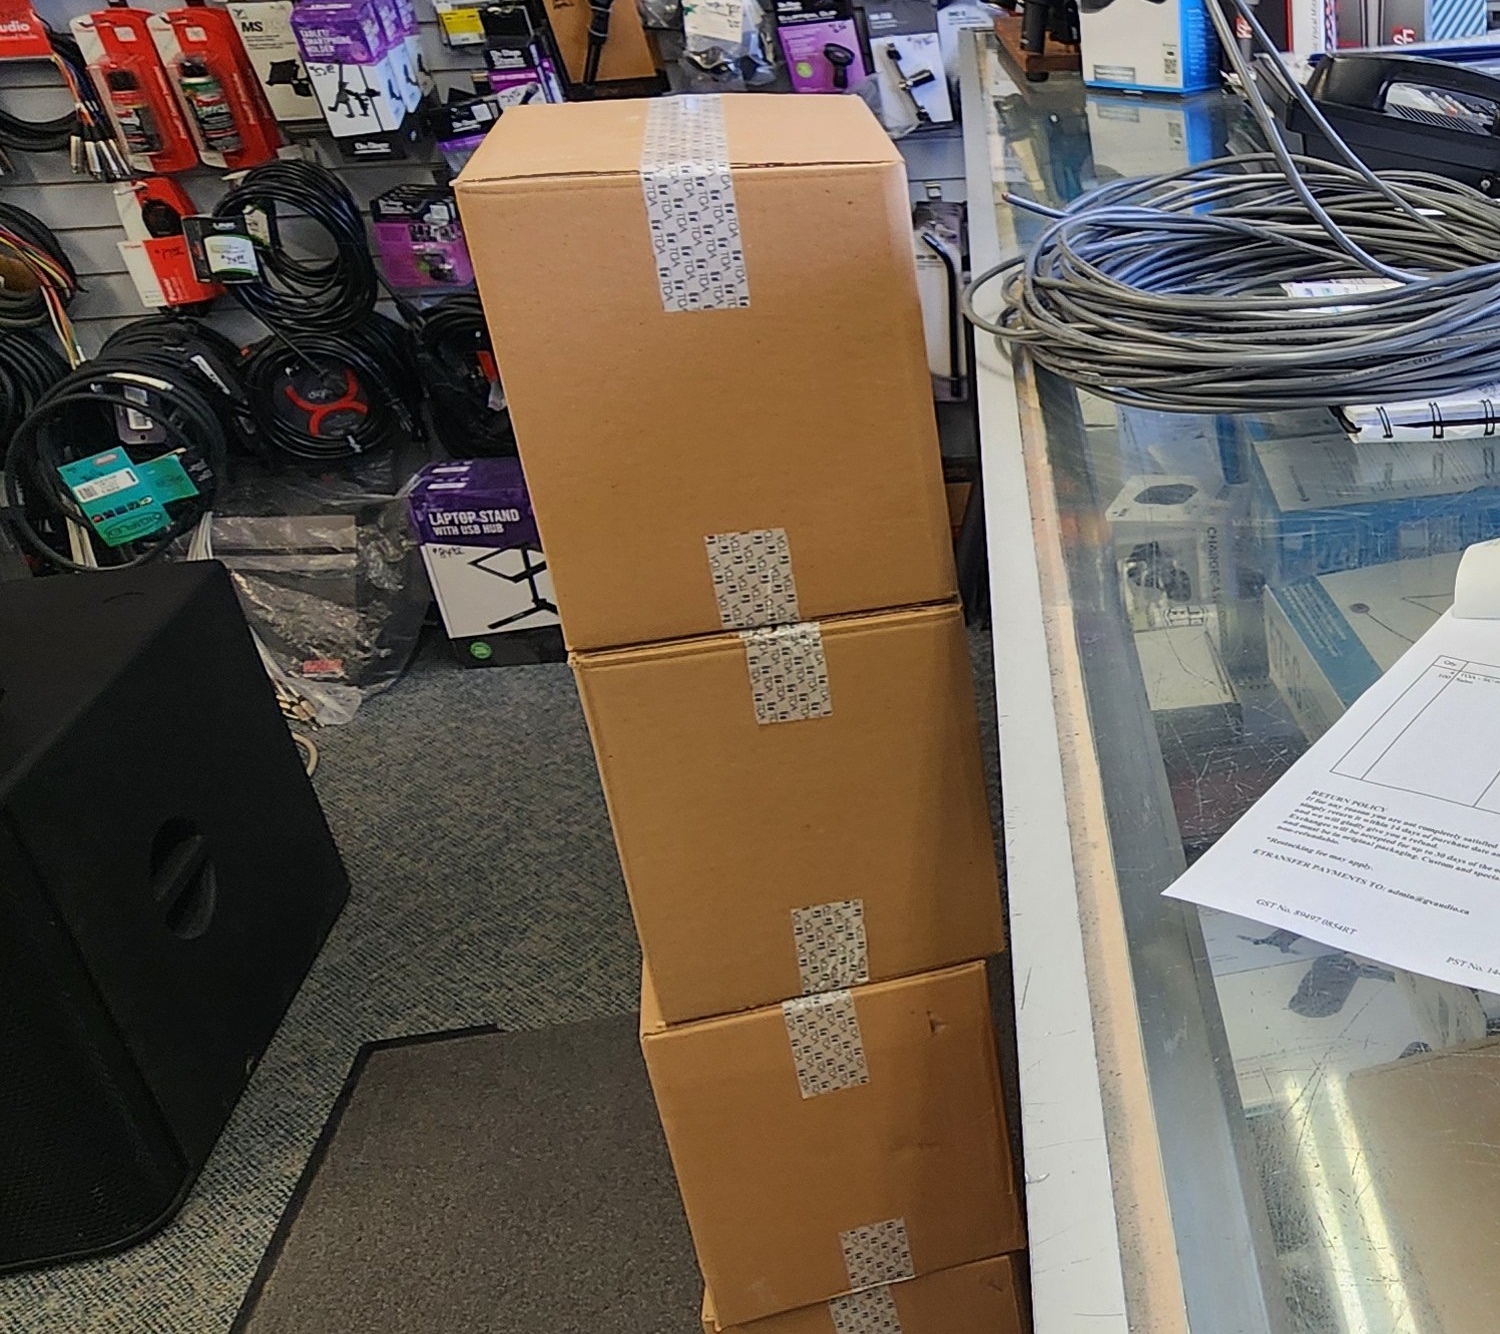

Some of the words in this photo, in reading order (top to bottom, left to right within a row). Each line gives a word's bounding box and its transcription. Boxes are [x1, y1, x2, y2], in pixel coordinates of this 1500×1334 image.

[428, 510, 476, 526] LAPTOP
[478, 509, 520, 523] STAND
[432, 525, 460, 536] WITH
[461, 525, 482, 535] USB
[482, 523, 504, 534] HUB
[1311, 789, 1350, 804] RETURN
[1352, 800, 1388, 813] POLICY
[1289, 813, 1331, 828] Exchanges
[1418, 824, 1461, 841] completely
[1463, 835, 1498, 850] satisfied
[1252, 848, 1312, 869] ETRANSFER
[1312, 863, 1367, 885] PAYMENTS
[1368, 881, 1387, 892] TO:
[1386, 887, 1470, 916] admin@gvaudio.ca
[1255, 898, 1277, 910] GST
[1278, 904, 1292, 914] No.
[1445, 956, 1467, 968] PST
[1468, 962, 1483, 973] No.
